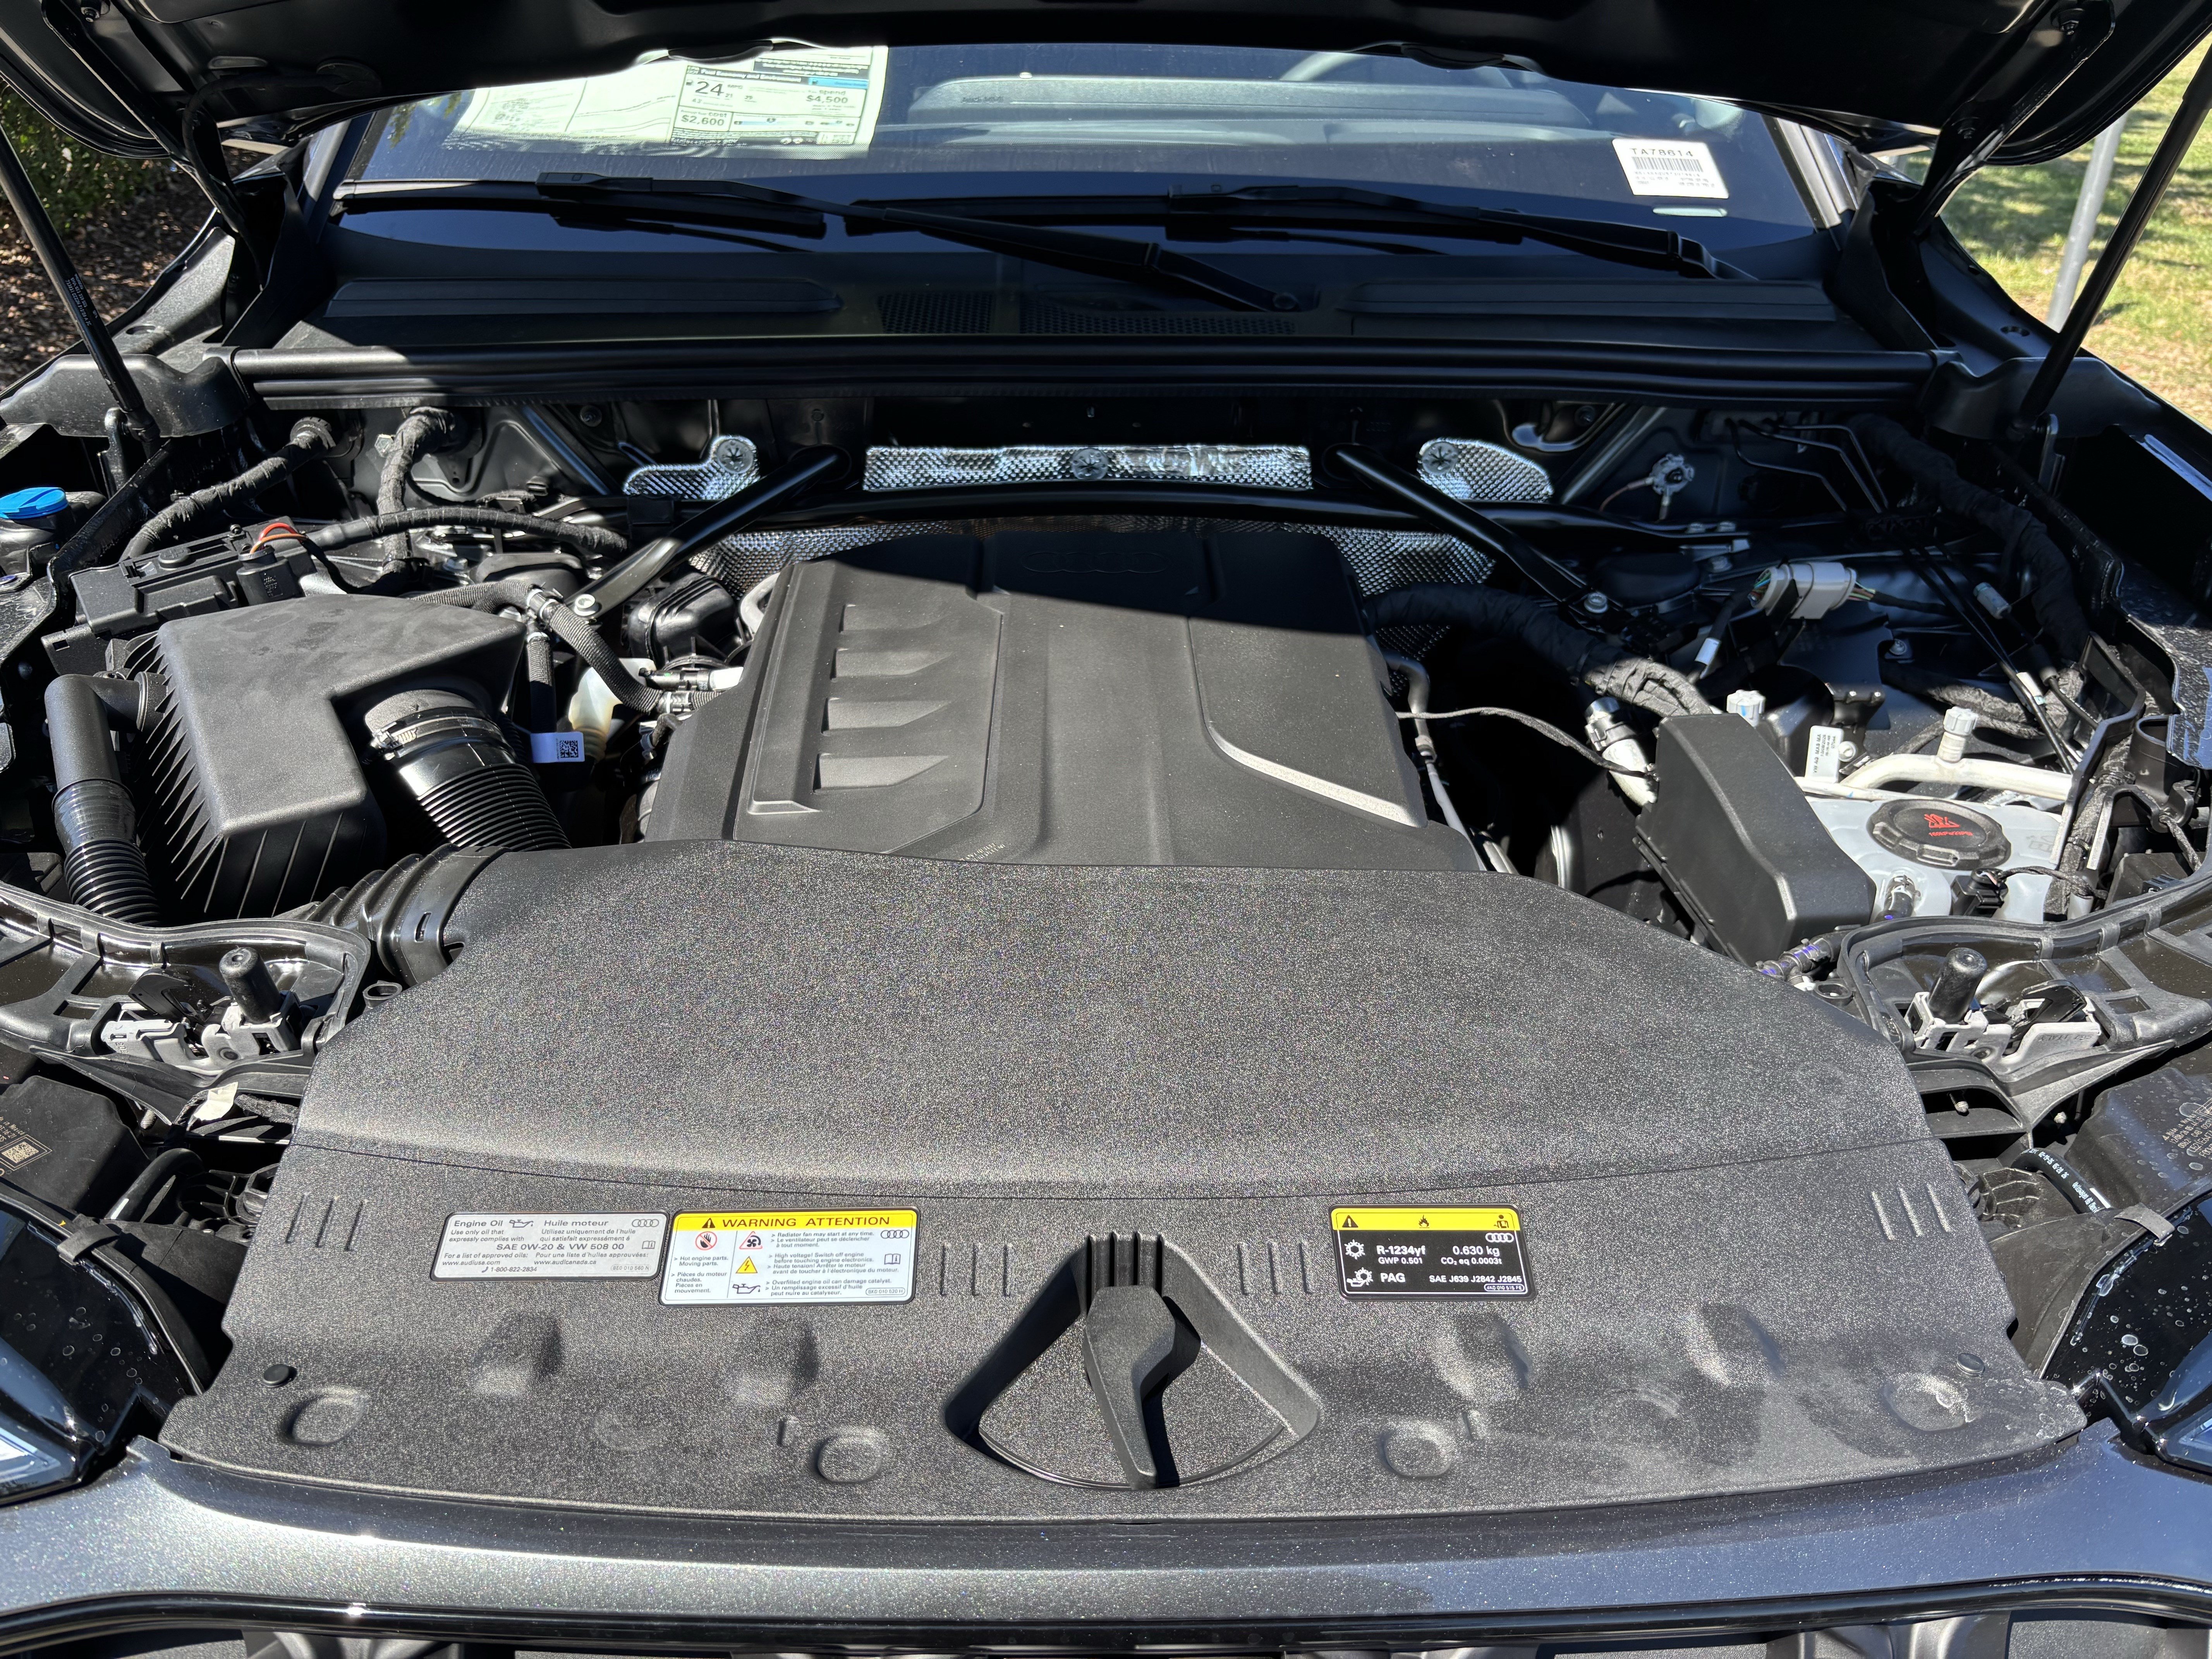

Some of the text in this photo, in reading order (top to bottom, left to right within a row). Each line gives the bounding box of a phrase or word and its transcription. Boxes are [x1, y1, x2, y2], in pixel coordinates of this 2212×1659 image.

[695, 81, 724, 96] 24
[681, 115, 724, 126] $2,600
[722, 1217, 890, 1228] WARNING ATTENTION
[1376, 1245, 1500, 1257] R-1234yf 0.630 kg
[1380, 1273, 1406, 1283] PAG
